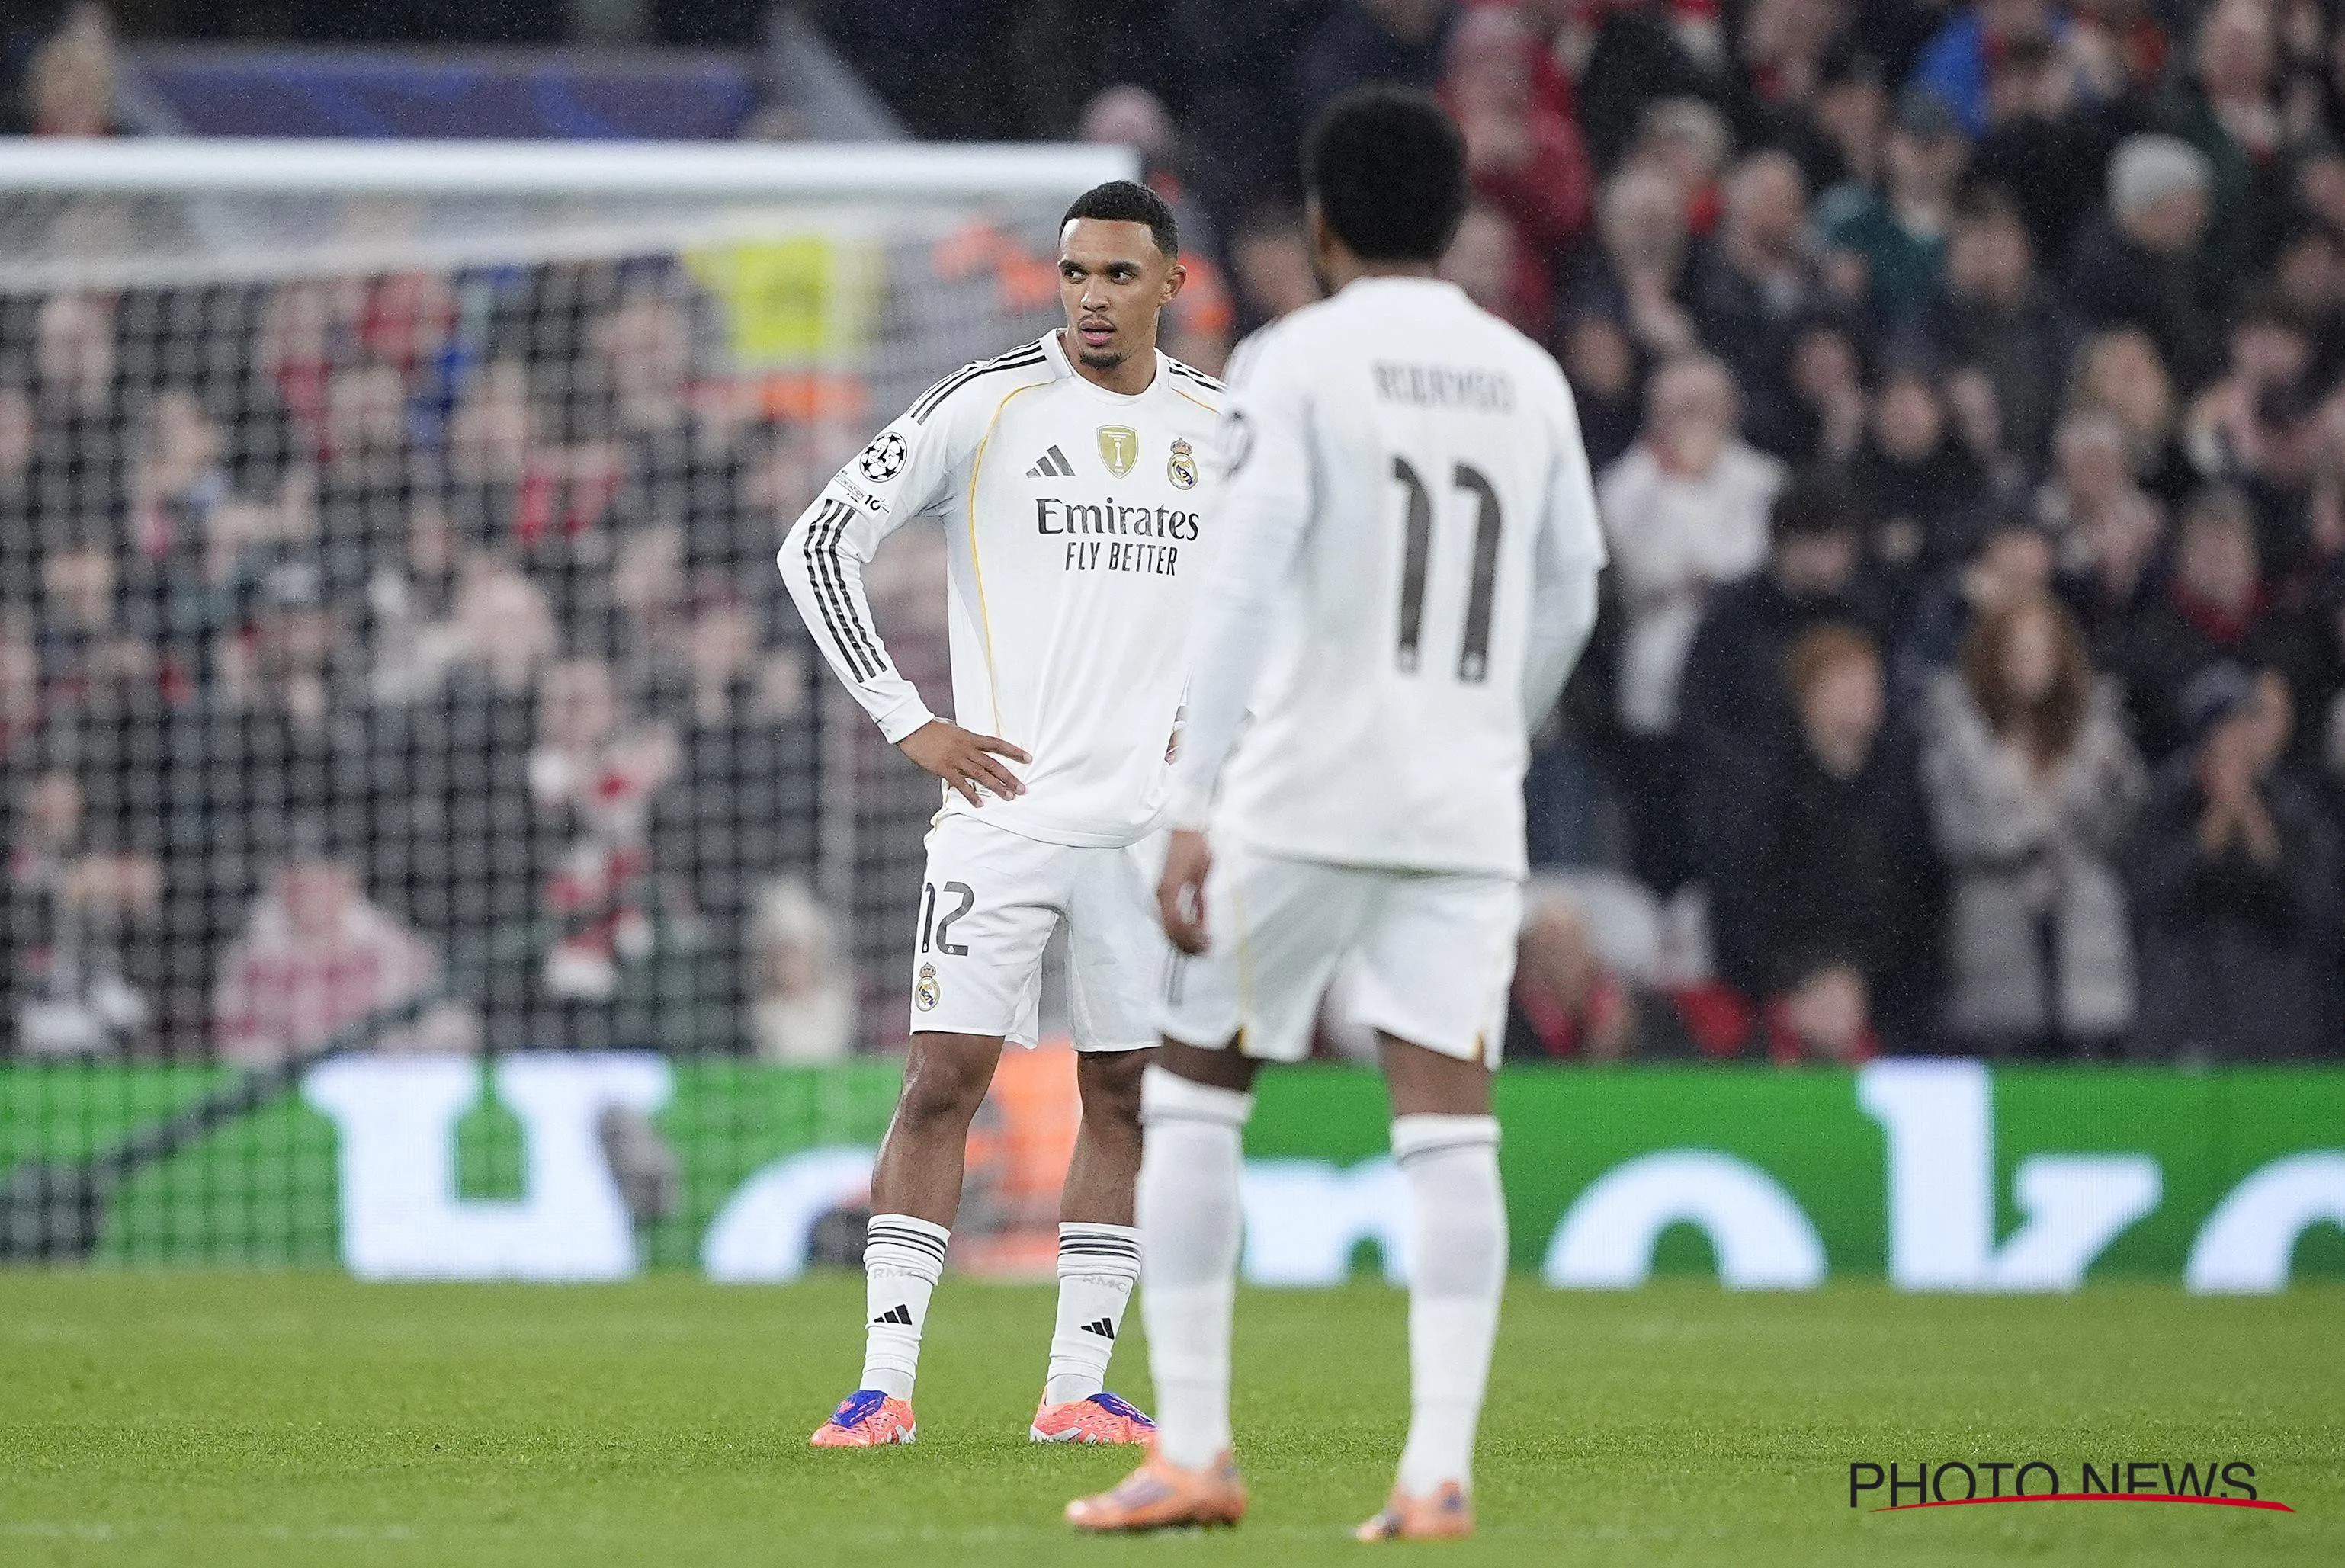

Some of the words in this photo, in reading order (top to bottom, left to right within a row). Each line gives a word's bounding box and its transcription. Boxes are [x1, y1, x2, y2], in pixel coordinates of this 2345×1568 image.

[1035, 497, 1199, 541] Emirates
[1065, 542, 1101, 570] FLY
[1108, 542, 1178, 576] BETTER
[1392, 454, 1502, 683] 11
[922, 881, 974, 957] 12
